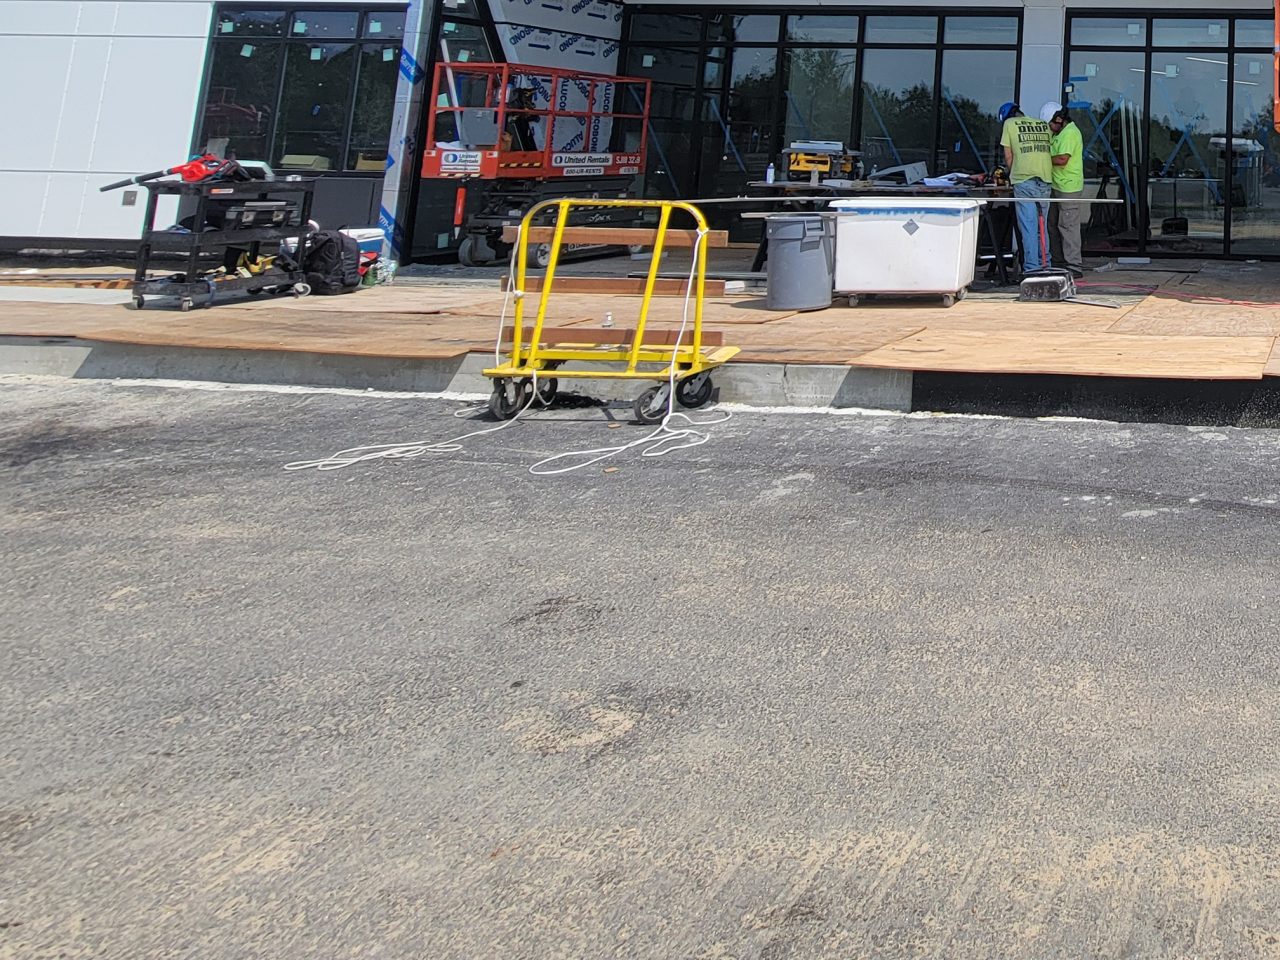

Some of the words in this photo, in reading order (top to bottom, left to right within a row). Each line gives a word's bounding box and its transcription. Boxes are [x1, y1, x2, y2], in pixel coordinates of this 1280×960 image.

[603, 81, 612, 114] ALUCO
[1018, 125, 1049, 133] DROP
[564, 155, 586, 163] United
[587, 155, 609, 163] Rentals
